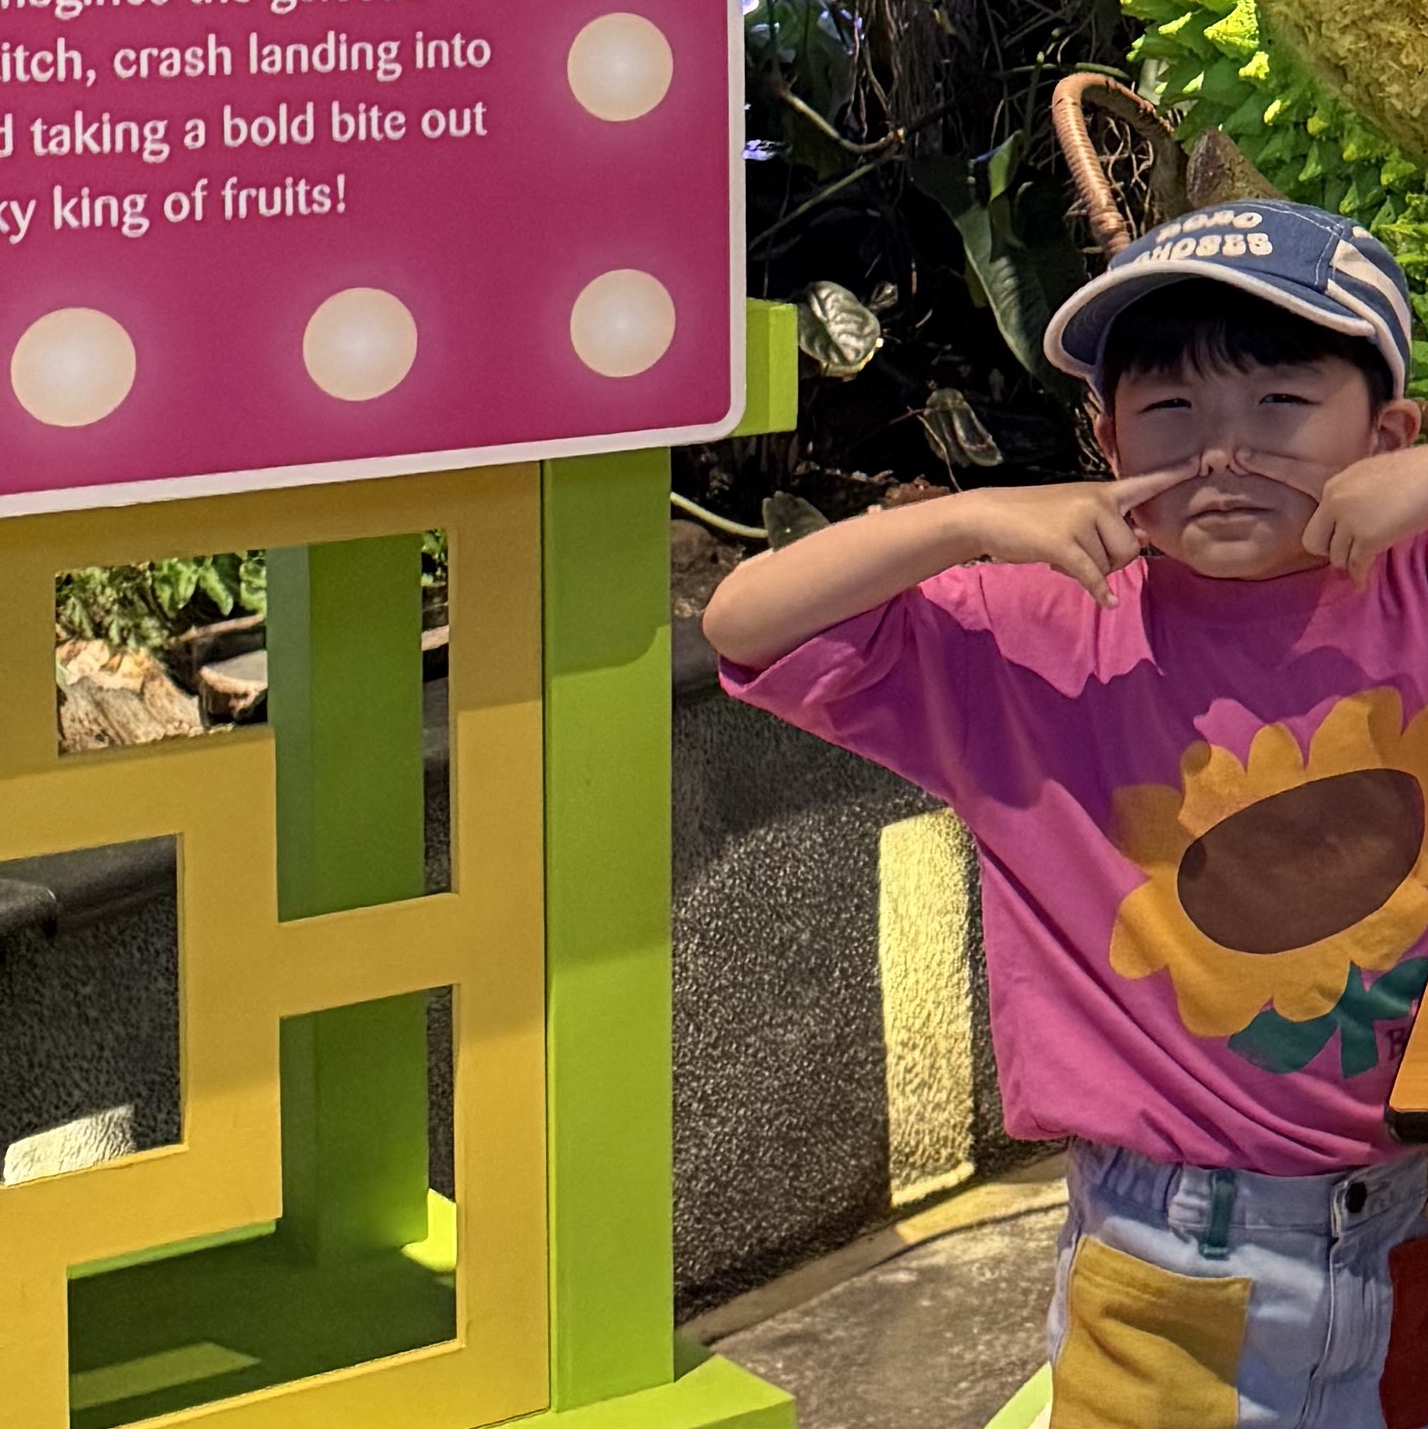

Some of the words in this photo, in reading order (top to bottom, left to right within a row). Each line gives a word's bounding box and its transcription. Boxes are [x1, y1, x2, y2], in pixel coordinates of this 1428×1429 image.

[113, 33, 232, 79] crash
[249, 30, 404, 83] landing
[415, 31, 492, 70] into
[30, 110, 171, 164] taking
[183, 117, 206, 150] a
[223, 101, 315, 148] bold
[331, 100, 407, 143] bite
[421, 101, 488, 139] out
[53, 184, 151, 239] king
[163, 178, 208, 224] of
[221, 174, 347, 220] fruits!
